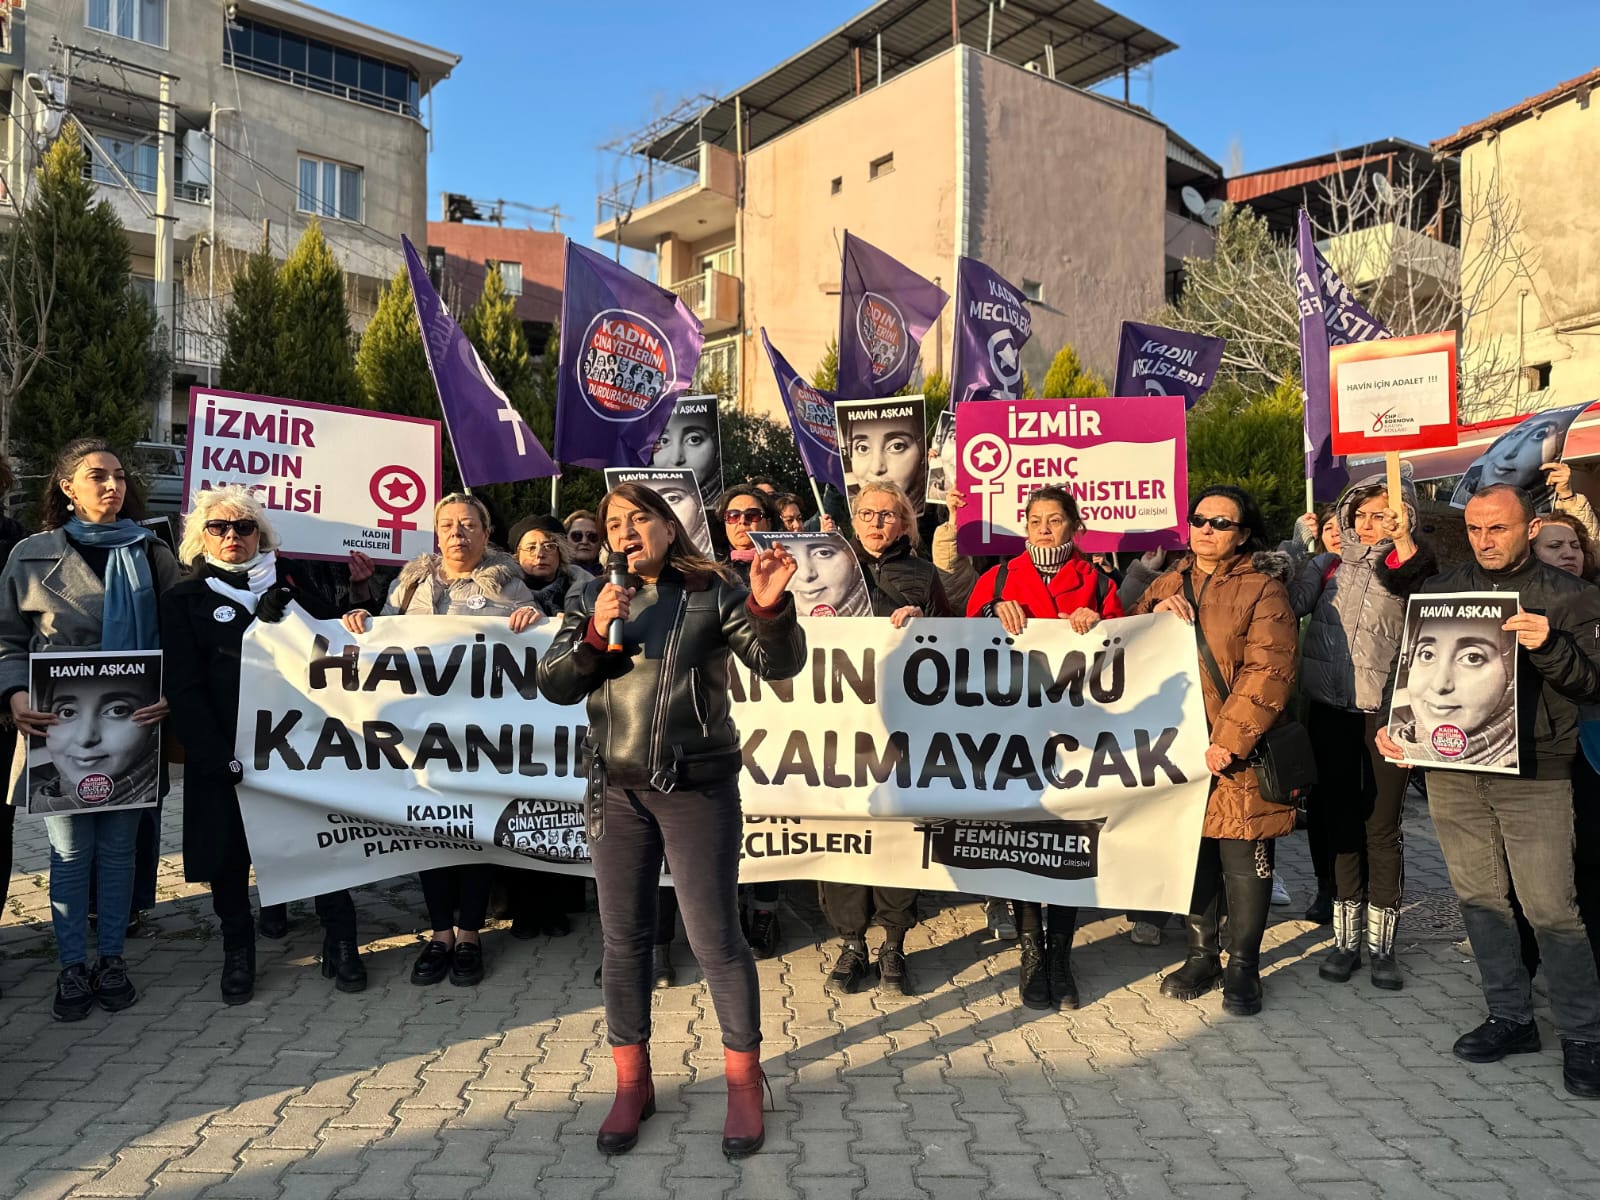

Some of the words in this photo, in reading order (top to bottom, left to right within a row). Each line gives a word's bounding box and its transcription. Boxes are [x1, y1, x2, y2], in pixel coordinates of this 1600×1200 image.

[602, 318, 659, 351] KADIN
[1140, 339, 1198, 367] KADIN
[1346, 381, 1372, 392] HAVİN
[1392, 377, 1424, 387] ADALET
[680, 404, 708, 415] AŞKAN
[848, 409, 878, 421] HAVİN
[880, 406, 913, 419] AŞKAN
[204, 400, 315, 448] İZMİR
[1008, 403, 1102, 439] İZMİR
[201, 446, 302, 479] KADIN
[1016, 456, 1078, 479] GENÇ
[618, 472, 649, 482] HAVİN
[651, 472, 684, 480] AŞKAN
[362, 529, 391, 540] KADIN
[342, 539, 390, 550] MECLİSLERİ
[1420, 603, 1454, 618] HAVİN
[1456, 606, 1502, 619] AŞKAN
[50, 662, 94, 677] HAVİN
[98, 663, 146, 677] AŞKAN
[308, 633, 538, 700] HAVİN
[903, 634, 1126, 708] ÖLÜMÜ
[741, 727, 1189, 792] KALMAYACAK
[407, 803, 474, 822] KADIN
[517, 800, 580, 815] KADIN
[363, 838, 483, 857] PLATFORMU
[954, 828, 1092, 854] FEMİNİSTLER
[953, 845, 1062, 868] FEDERASYONU
